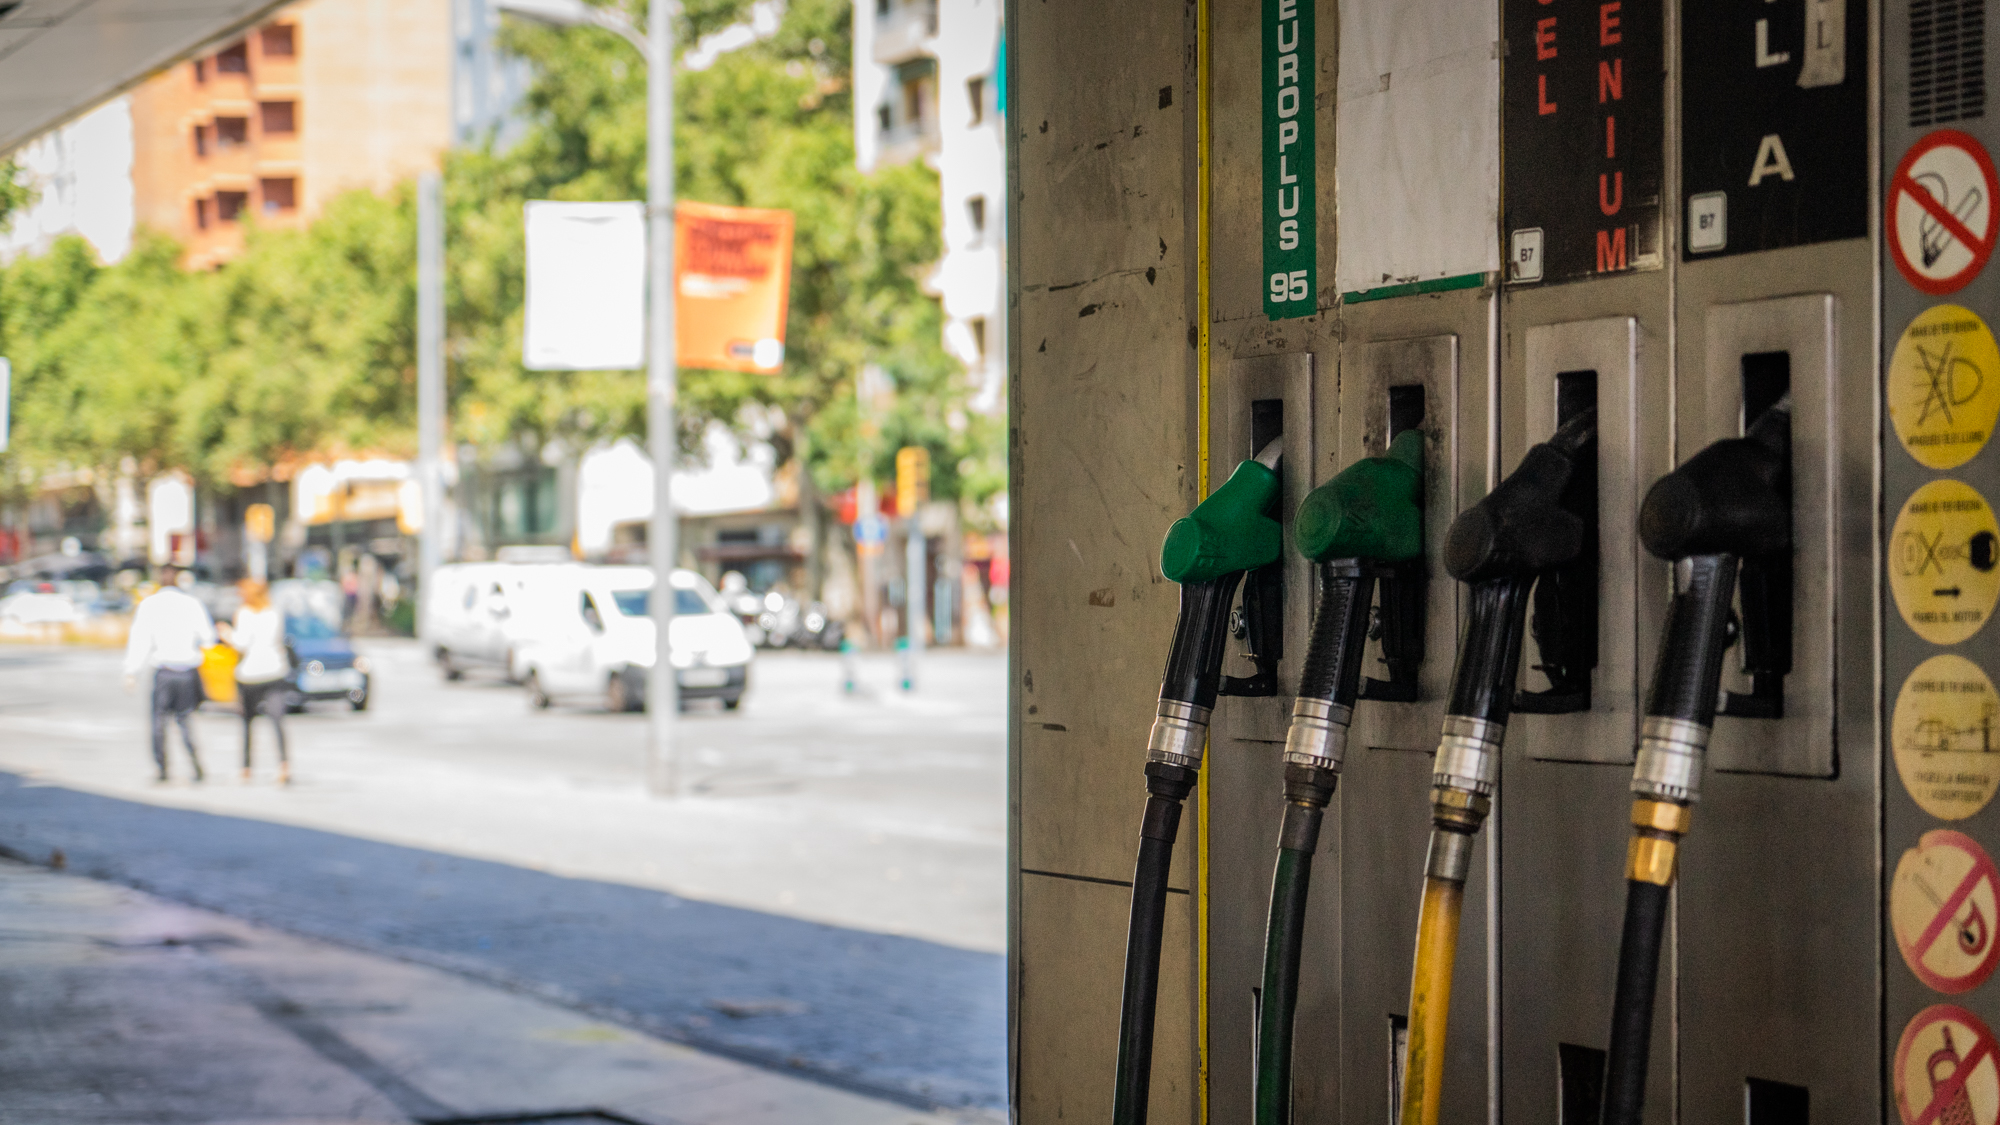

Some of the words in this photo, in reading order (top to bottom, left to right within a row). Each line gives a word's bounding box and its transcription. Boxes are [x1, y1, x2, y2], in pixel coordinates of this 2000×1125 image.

[1536, 0, 1559, 116] EL
[1277, 0, 1299, 251] EUROPLUS
[1748, 133, 1795, 187] A
[1700, 213, 1715, 230] B7
[1520, 247, 1534, 262] B7
[1270, 270, 1308, 303] 95
